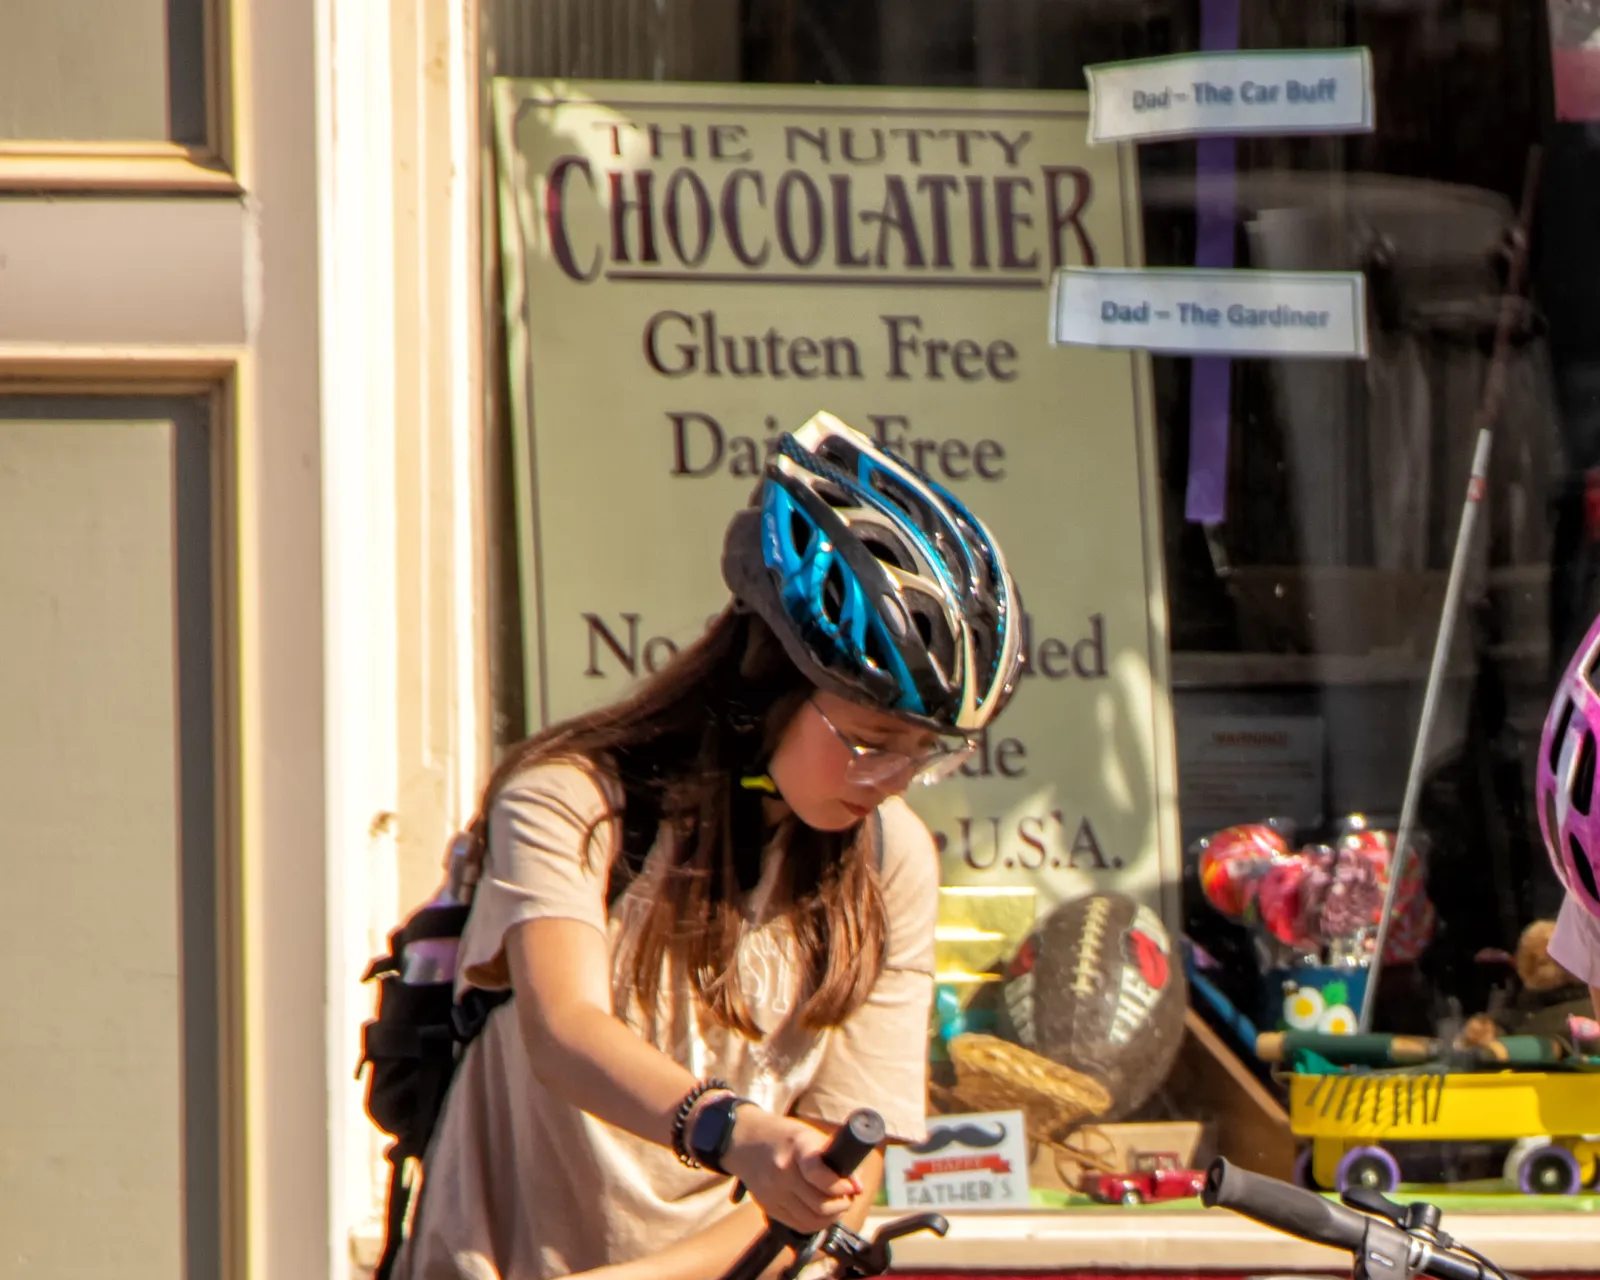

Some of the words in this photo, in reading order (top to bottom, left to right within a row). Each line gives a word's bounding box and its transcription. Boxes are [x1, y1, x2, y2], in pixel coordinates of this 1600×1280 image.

[1131, 86, 1172, 113] Dad
[1191, 81, 1235, 107] The
[1240, 79, 1280, 103] Car
[1285, 76, 1338, 102] Buff
[593, 121, 754, 163] THE
[785, 125, 1033, 167] NUTTY
[546, 154, 1098, 283] CHOCOLATIER
[1100, 300, 1149, 324] Dad
[1176, 302, 1221, 327] The
[1226, 302, 1330, 329] Gardiner
[642, 309, 864, 380] Gluten
[880, 314, 1020, 383] Free
[665, 410, 780, 479] Dai
[867, 414, 1006, 481] Free
[580, 612, 681, 680] No
[956, 815, 1124, 870] U.S.A.
